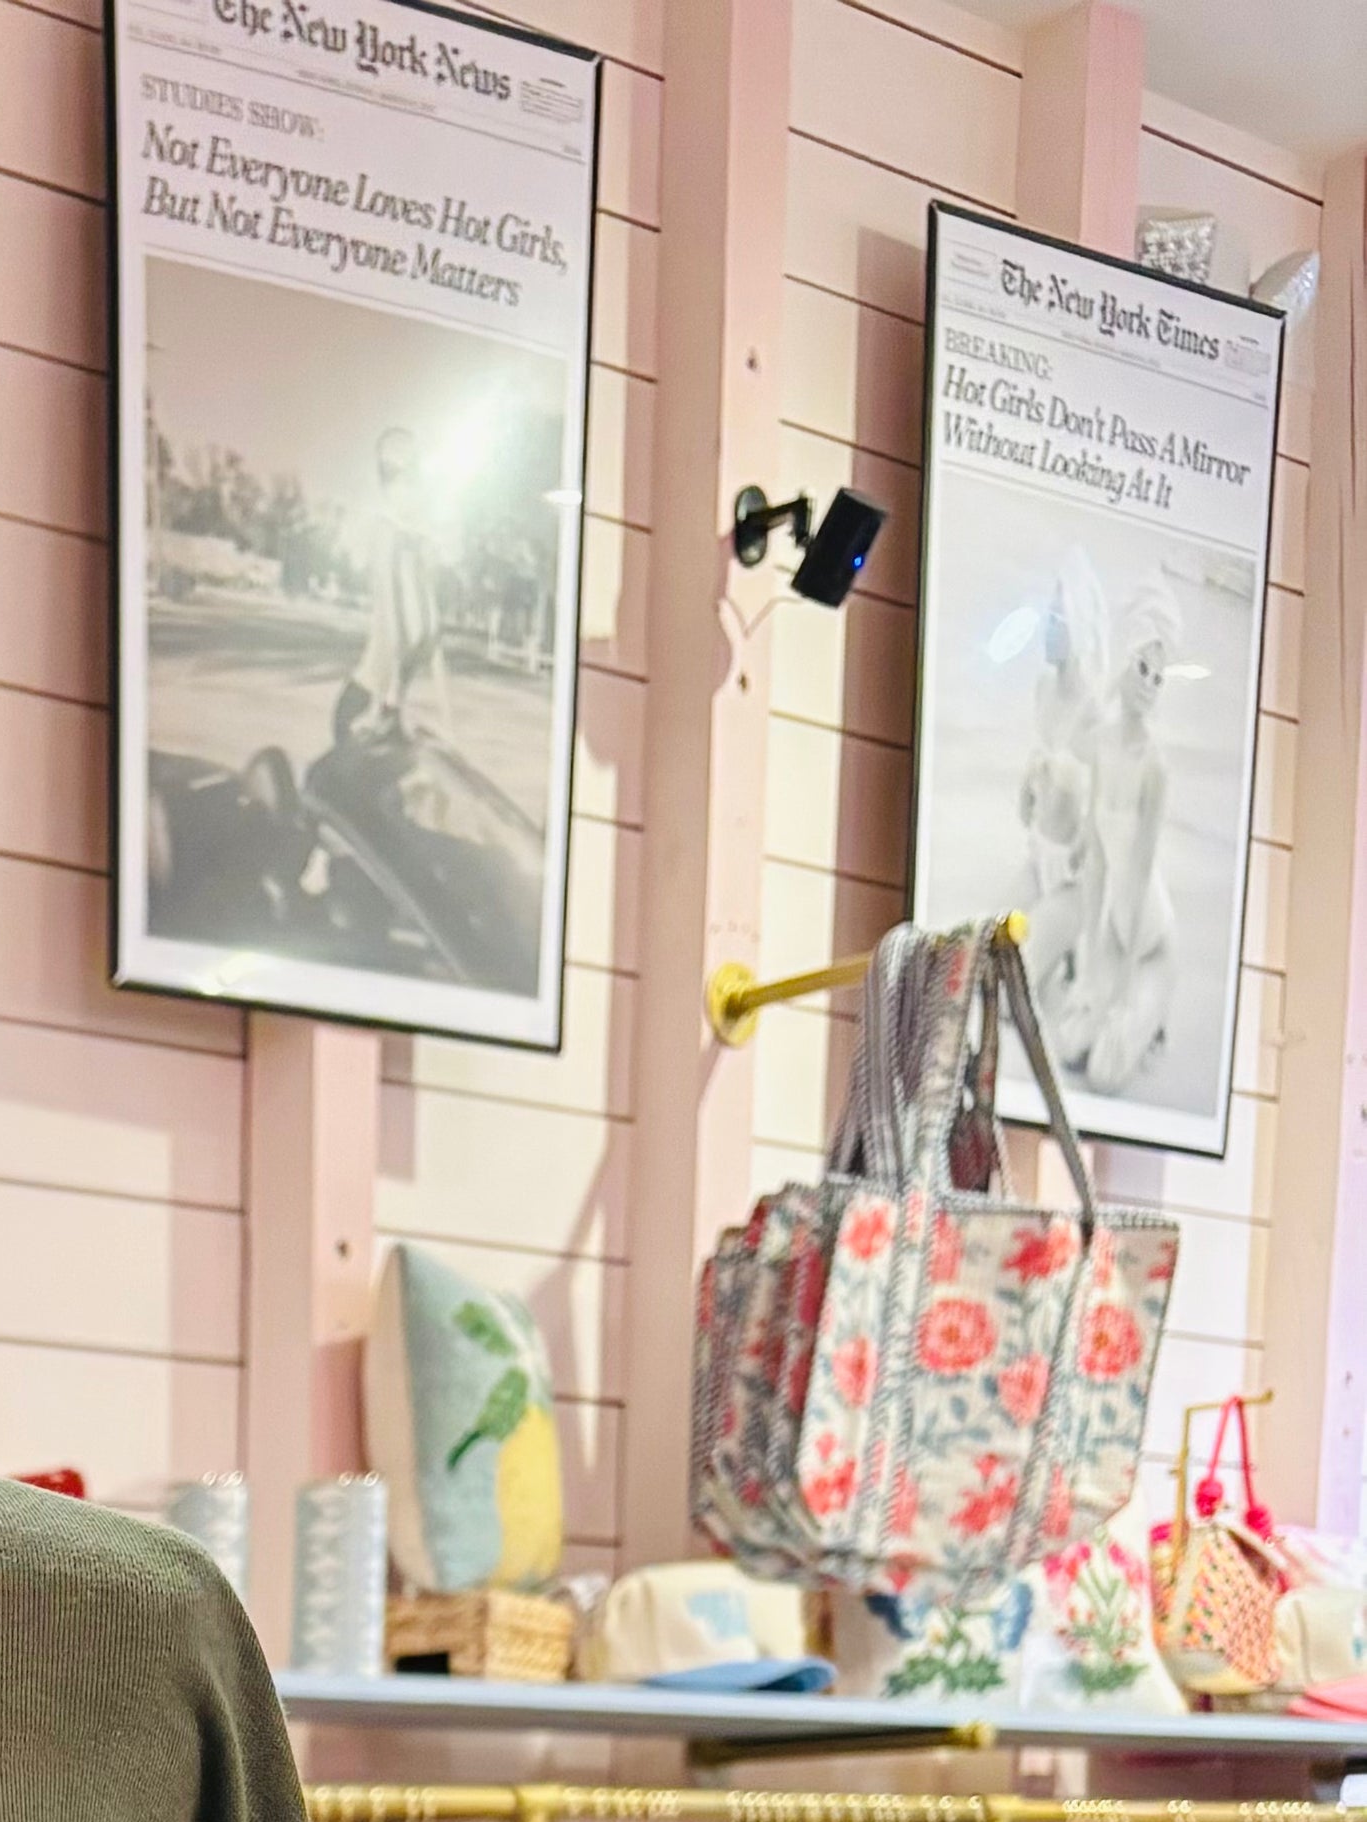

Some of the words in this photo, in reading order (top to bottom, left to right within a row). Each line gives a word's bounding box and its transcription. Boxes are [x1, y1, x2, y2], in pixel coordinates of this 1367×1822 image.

[140, 73, 244, 121] STUDIES
[213, 0, 271, 36] The
[281, 0, 347, 52] New
[356, 19, 427, 76] York
[435, 42, 511, 100] News
[142, 175, 200, 225] But
[205, 190, 263, 240] Not
[267, 206, 407, 276] Everyone
[411, 242, 522, 307] Matters
[143, 120, 200, 170] Not
[205, 135, 350, 203] Everyone
[354, 172, 435, 230] Loves
[438, 196, 491, 245] Hot
[496, 212, 567, 276] Girls,
[1001, 259, 1043, 306] The
[1047, 275, 1094, 319] New
[1099, 290, 1151, 338] York
[1157, 308, 1220, 360] Times
[943, 364, 986, 407] Hot
[990, 378, 1045, 424] Girls
[1048, 395, 1105, 442] Don't
[1109, 414, 1158, 459] Pass
[1159, 432, 1176, 465] A
[1178, 435, 1252, 486] Mirror
[944, 411, 1036, 468] Without
[1039, 438, 1126, 503] Looking
[1126, 467, 1153, 502] At
[1155, 473, 1173, 509] It
